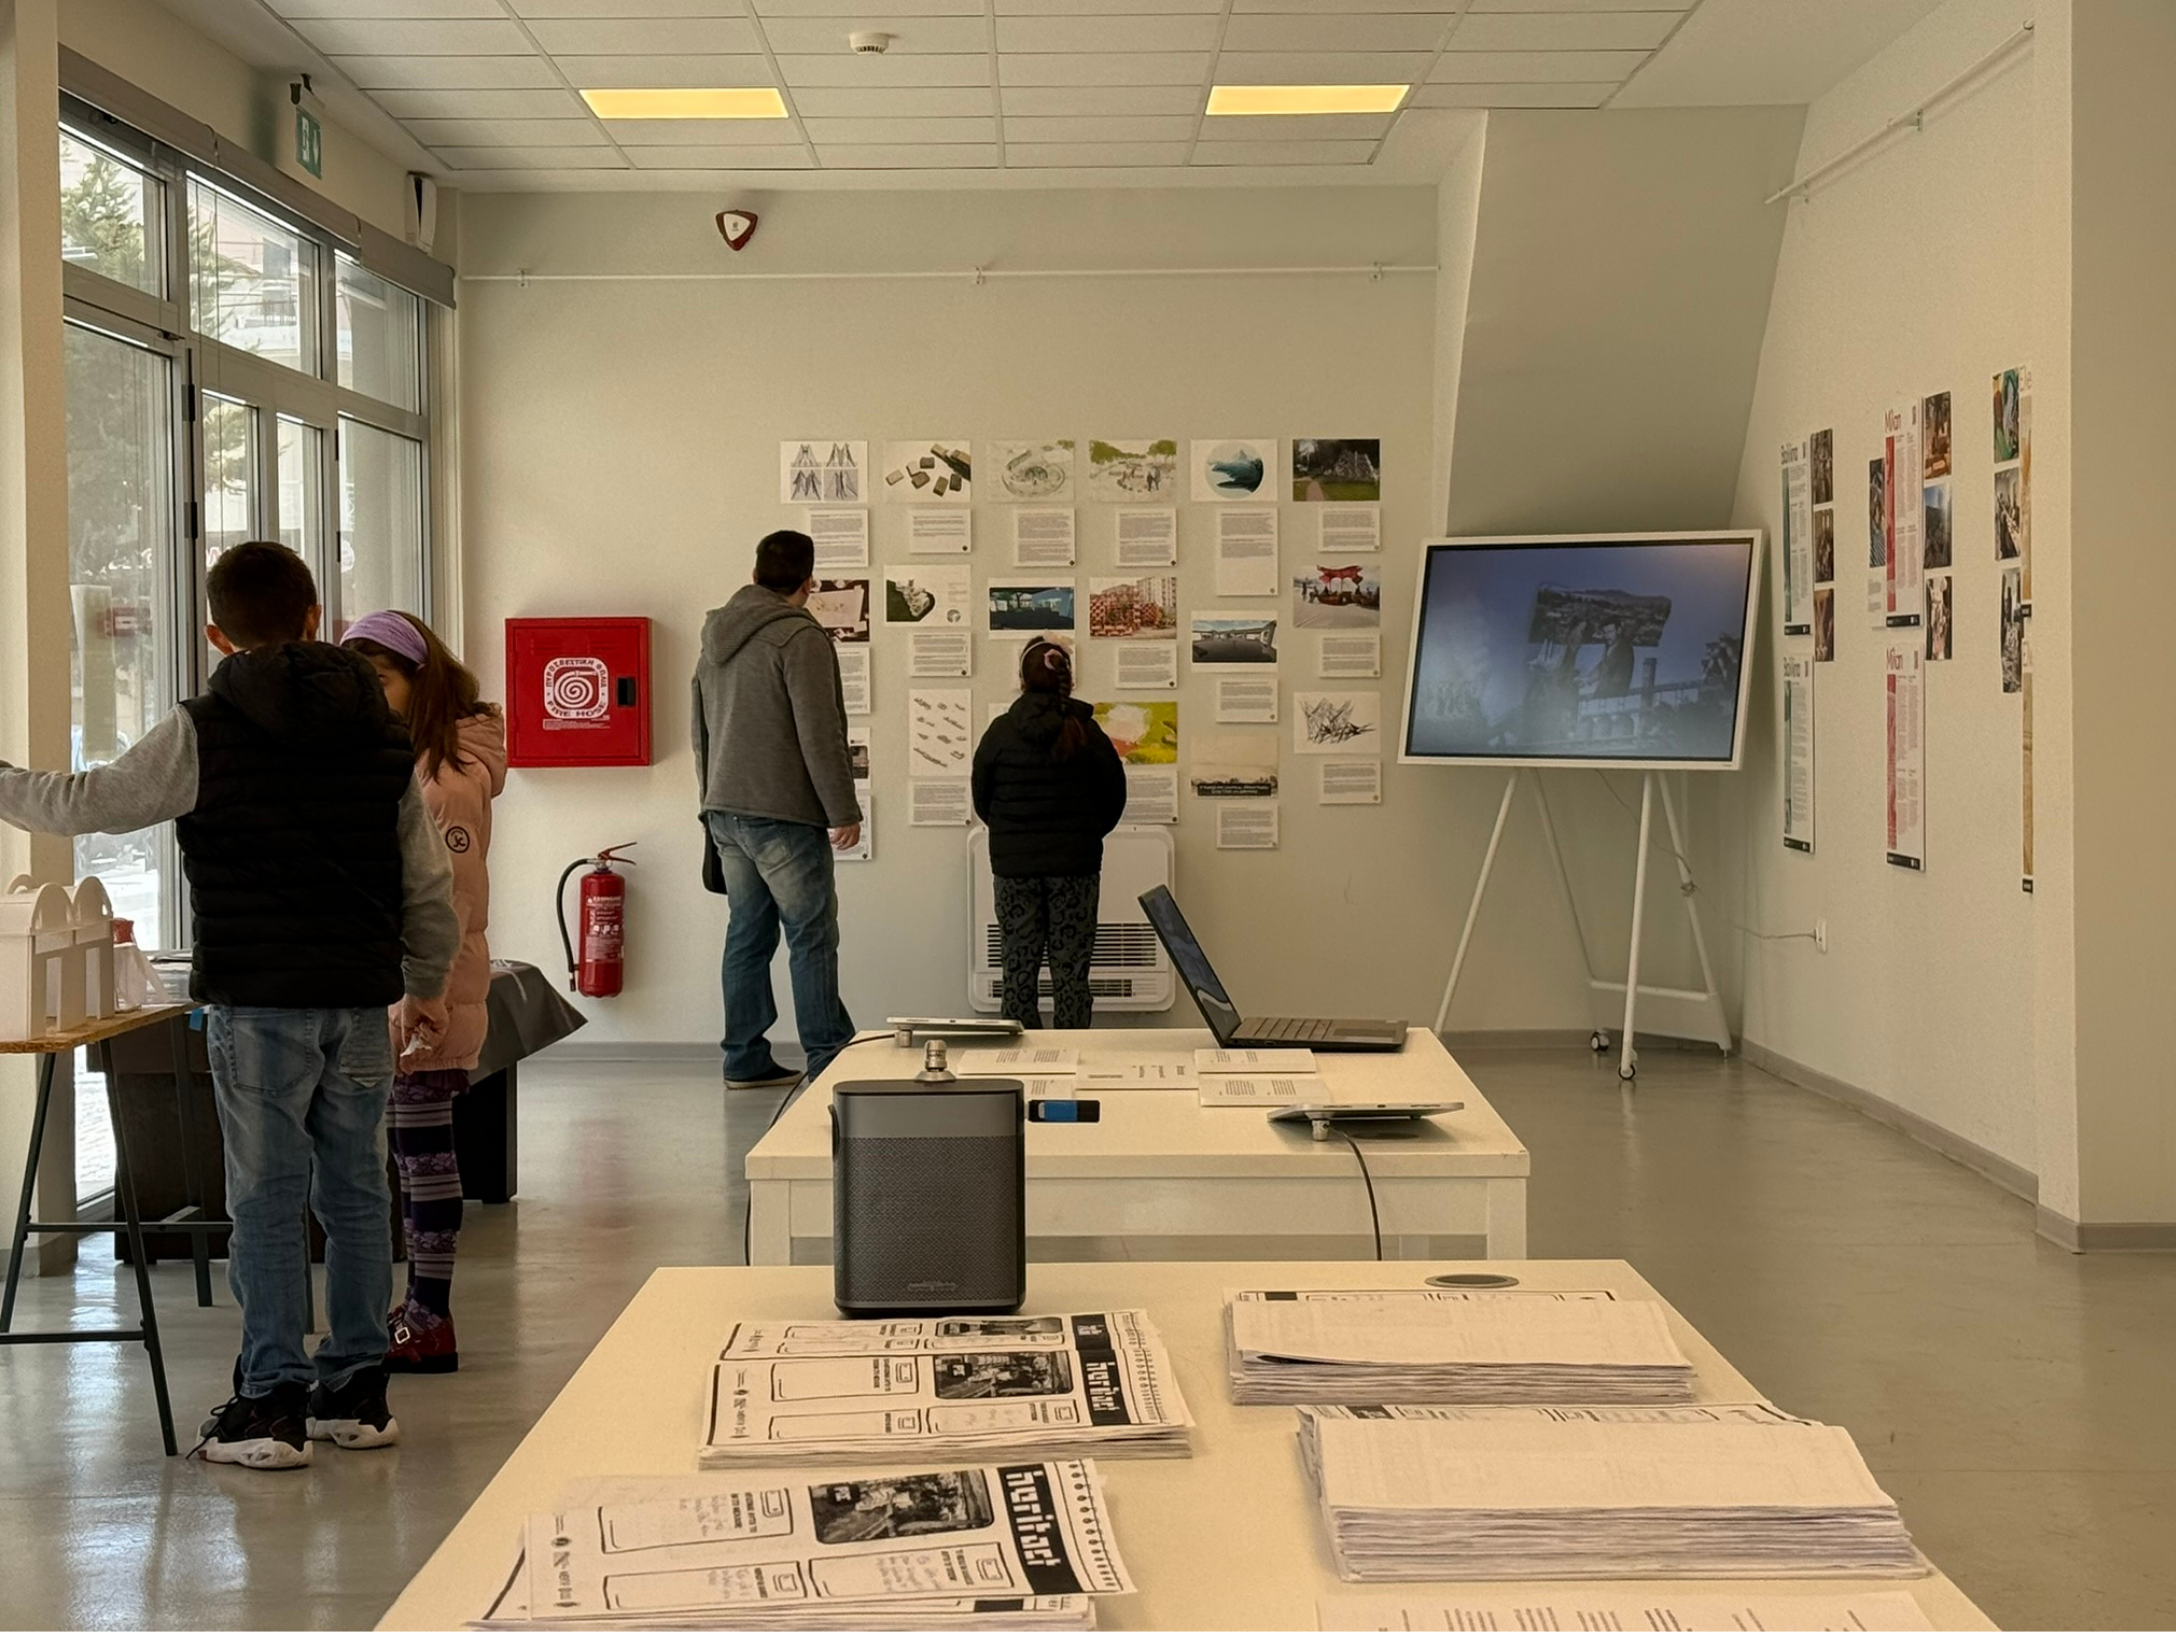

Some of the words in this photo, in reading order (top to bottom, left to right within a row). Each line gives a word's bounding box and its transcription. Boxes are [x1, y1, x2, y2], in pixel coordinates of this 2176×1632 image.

[547, 701, 571, 716] FIRE
[576, 702, 606, 717] HOSE
[1006, 1470, 1060, 1566] heritact
